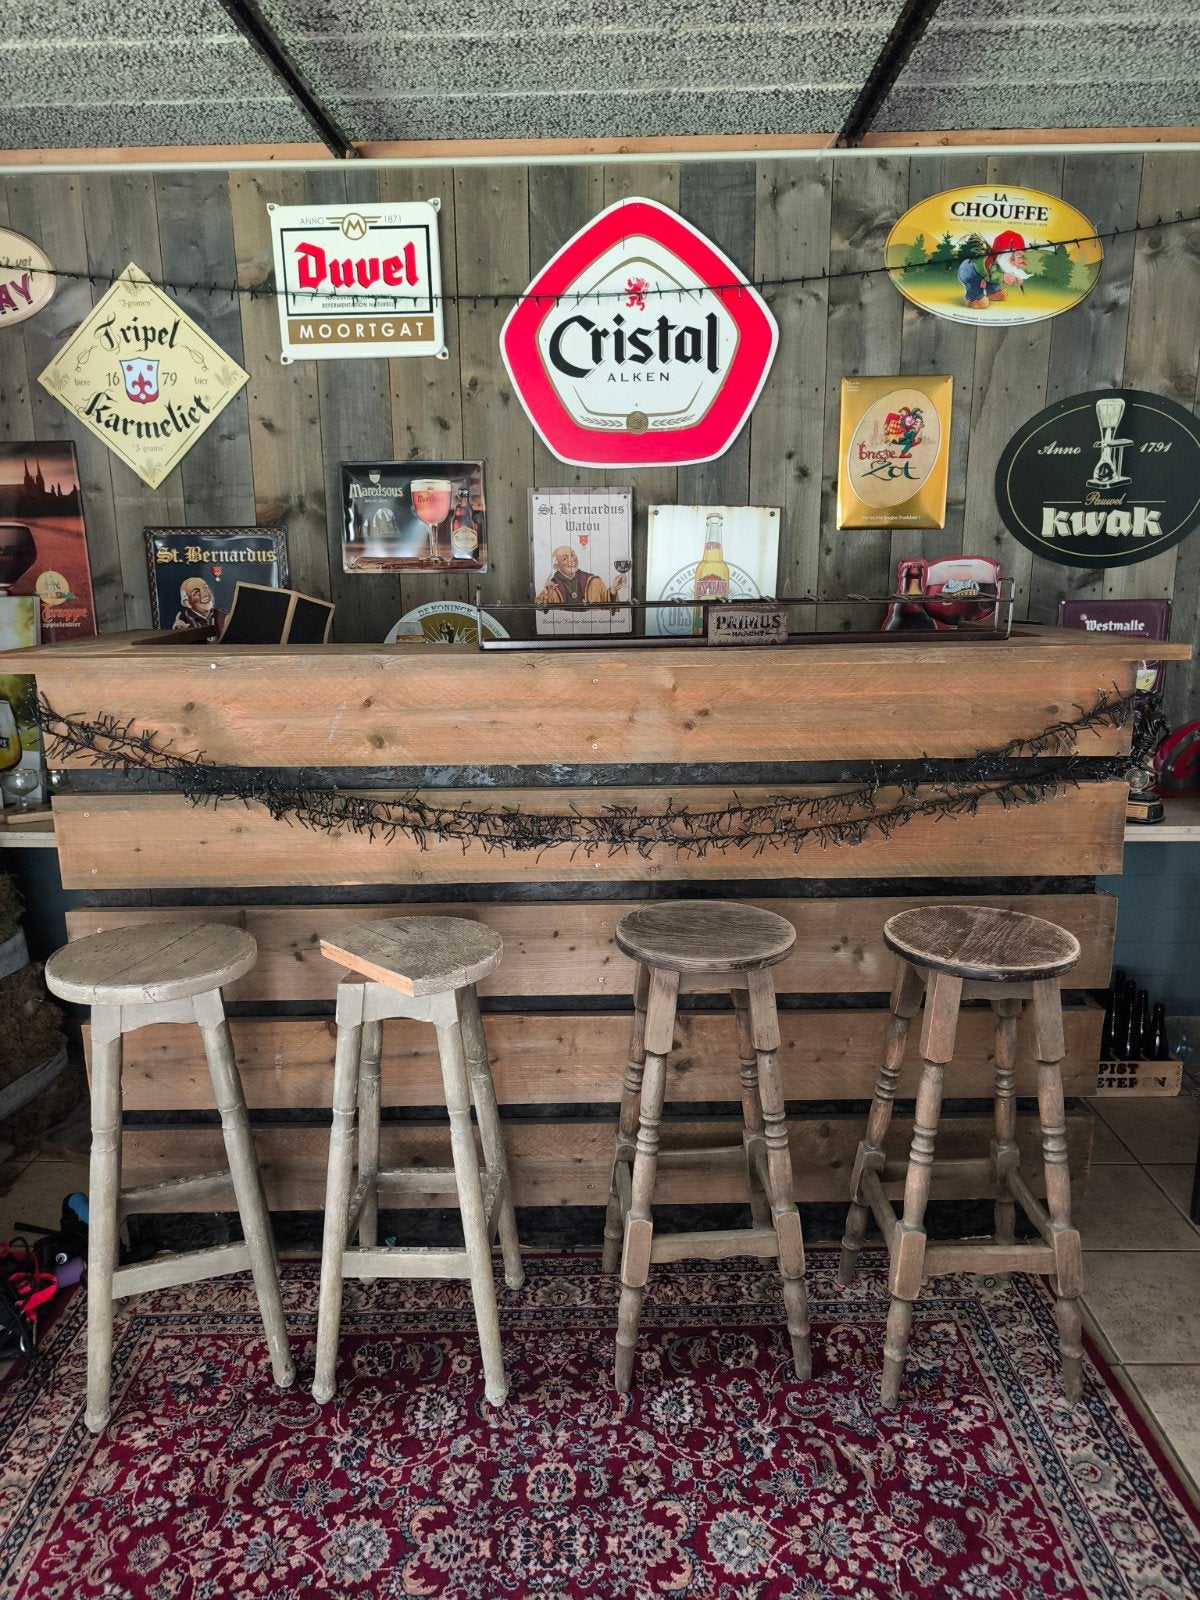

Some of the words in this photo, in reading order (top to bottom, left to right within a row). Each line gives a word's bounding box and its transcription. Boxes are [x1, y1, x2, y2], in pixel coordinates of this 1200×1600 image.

[994, 193, 1008, 202] LA
[951, 201, 1049, 221] CHOUFFE
[300, 216, 325, 226] ANNO
[383, 215, 402, 224] 1871
[294, 241, 420, 289] Duvel
[94, 311, 182, 354] Tripel
[299, 322, 424, 339] MOORTGAT
[549, 312, 723, 379] Cristal
[106, 372, 120, 387] 16
[162, 372, 178, 387] 79
[607, 372, 670, 382] ALKEN
[75, 389, 211, 439] Karmeliet
[1038, 441, 1081, 455] Anno
[861, 461, 920, 481] Zot
[349, 483, 404, 498] Maredsous
[1085, 491, 1127, 506] Pauwel
[538, 504, 556, 515] St.
[560, 503, 624, 516] Bernardus
[565, 520, 600, 531] Watou
[156, 546, 183, 563] St.
[185, 546, 277, 564] Bernardus
[731, 571, 747, 585] BIER
[418, 607, 431, 617] DE
[432, 605, 473, 615] KONINCK
[716, 615, 781, 629] PRIMUS
[1085, 620, 1146, 631] Westmalle
[1098, 1063, 1139, 1074] PIST
